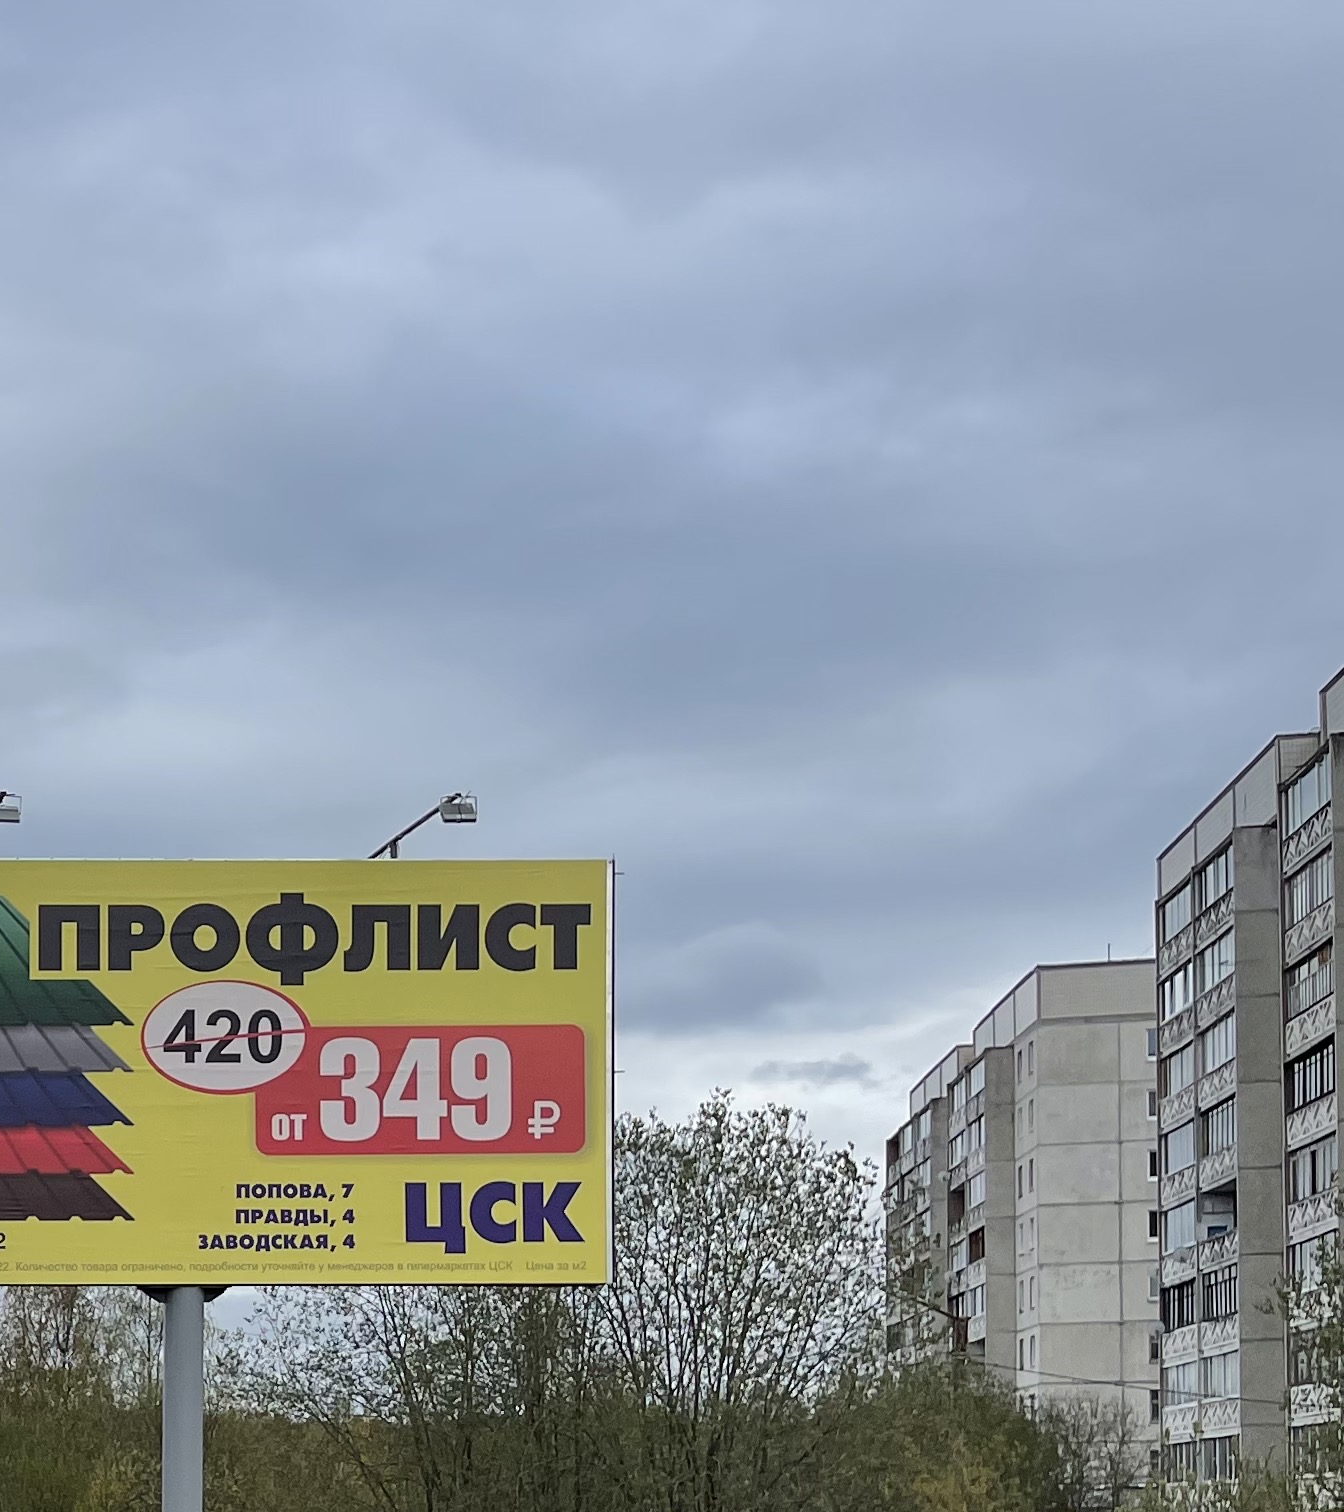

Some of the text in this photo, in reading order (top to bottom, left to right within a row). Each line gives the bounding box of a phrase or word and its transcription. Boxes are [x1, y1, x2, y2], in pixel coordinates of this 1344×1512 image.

[38, 892, 592, 985] ПРОФЛИСТ
[163, 1009, 283, 1064] 420
[320, 1036, 512, 1142] 349
[235, 1209, 355, 1227] ПРАВДЫ, 4
[236, 1183, 355, 1202] ПОПОВА, 7
[405, 1181, 585, 1254] ЦСК
[198, 1234, 355, 1252] ЗАВОДСКАЯ, 4
